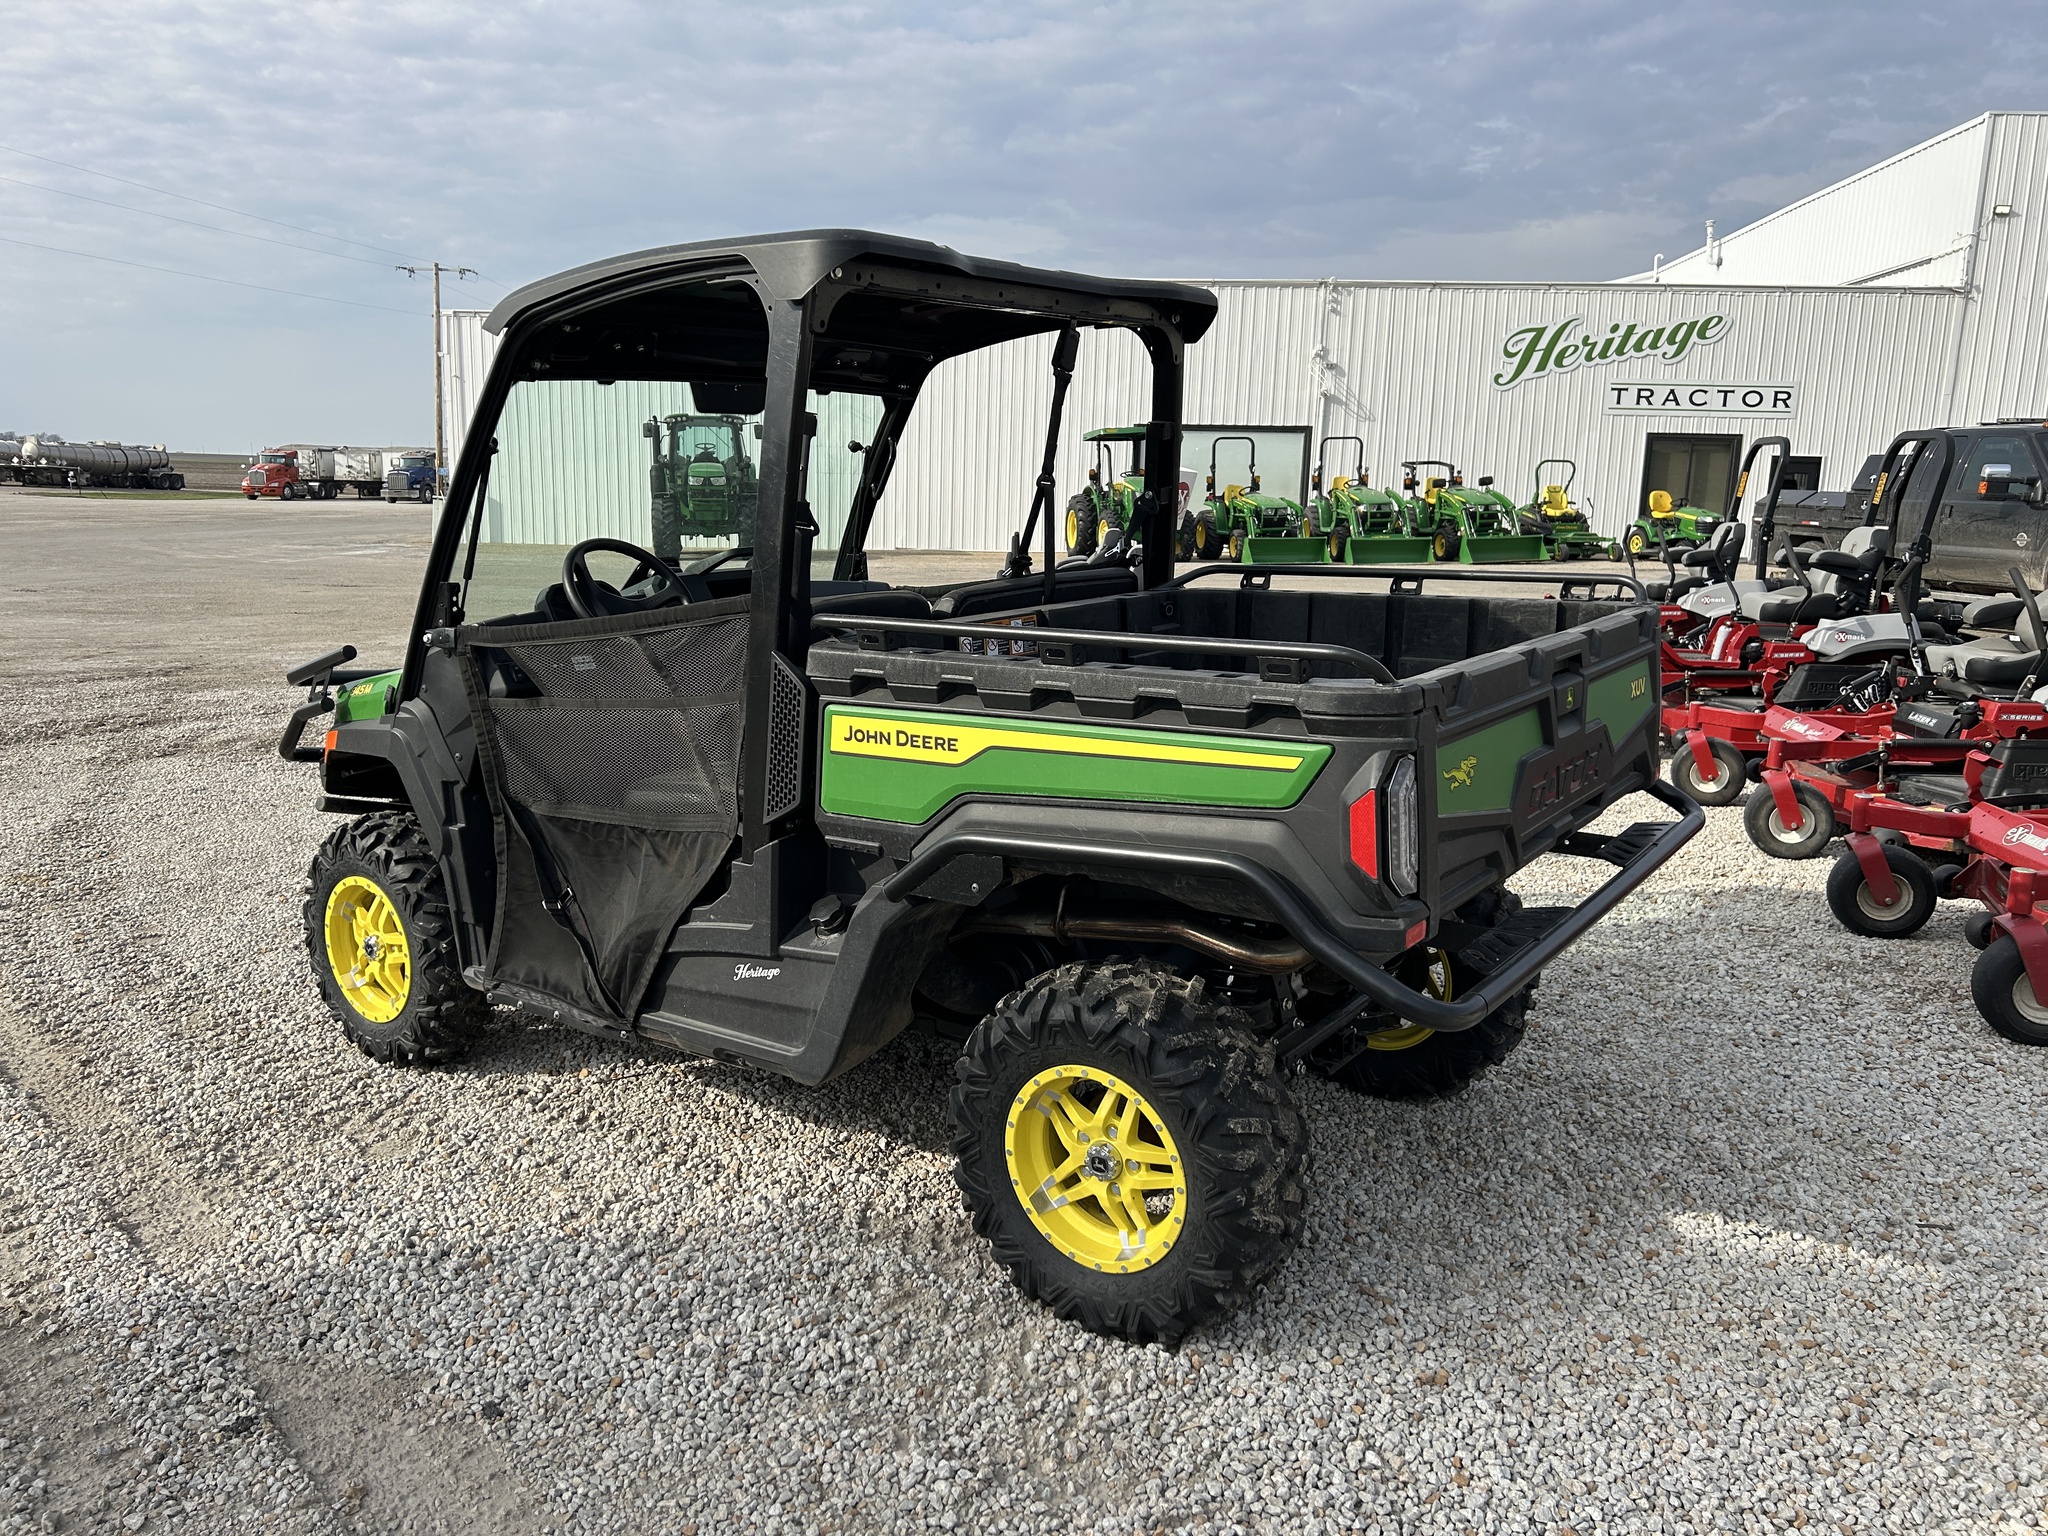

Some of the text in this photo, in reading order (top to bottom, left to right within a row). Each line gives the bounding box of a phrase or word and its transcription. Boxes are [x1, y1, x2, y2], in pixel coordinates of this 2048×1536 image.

[1493, 314, 1726, 387] Heritage
[1610, 387, 1792, 409] TRACTOR
[1631, 676, 1646, 699] XUV
[844, 725, 959, 753] JOHN DEERE
[733, 963, 781, 981] Heritage
